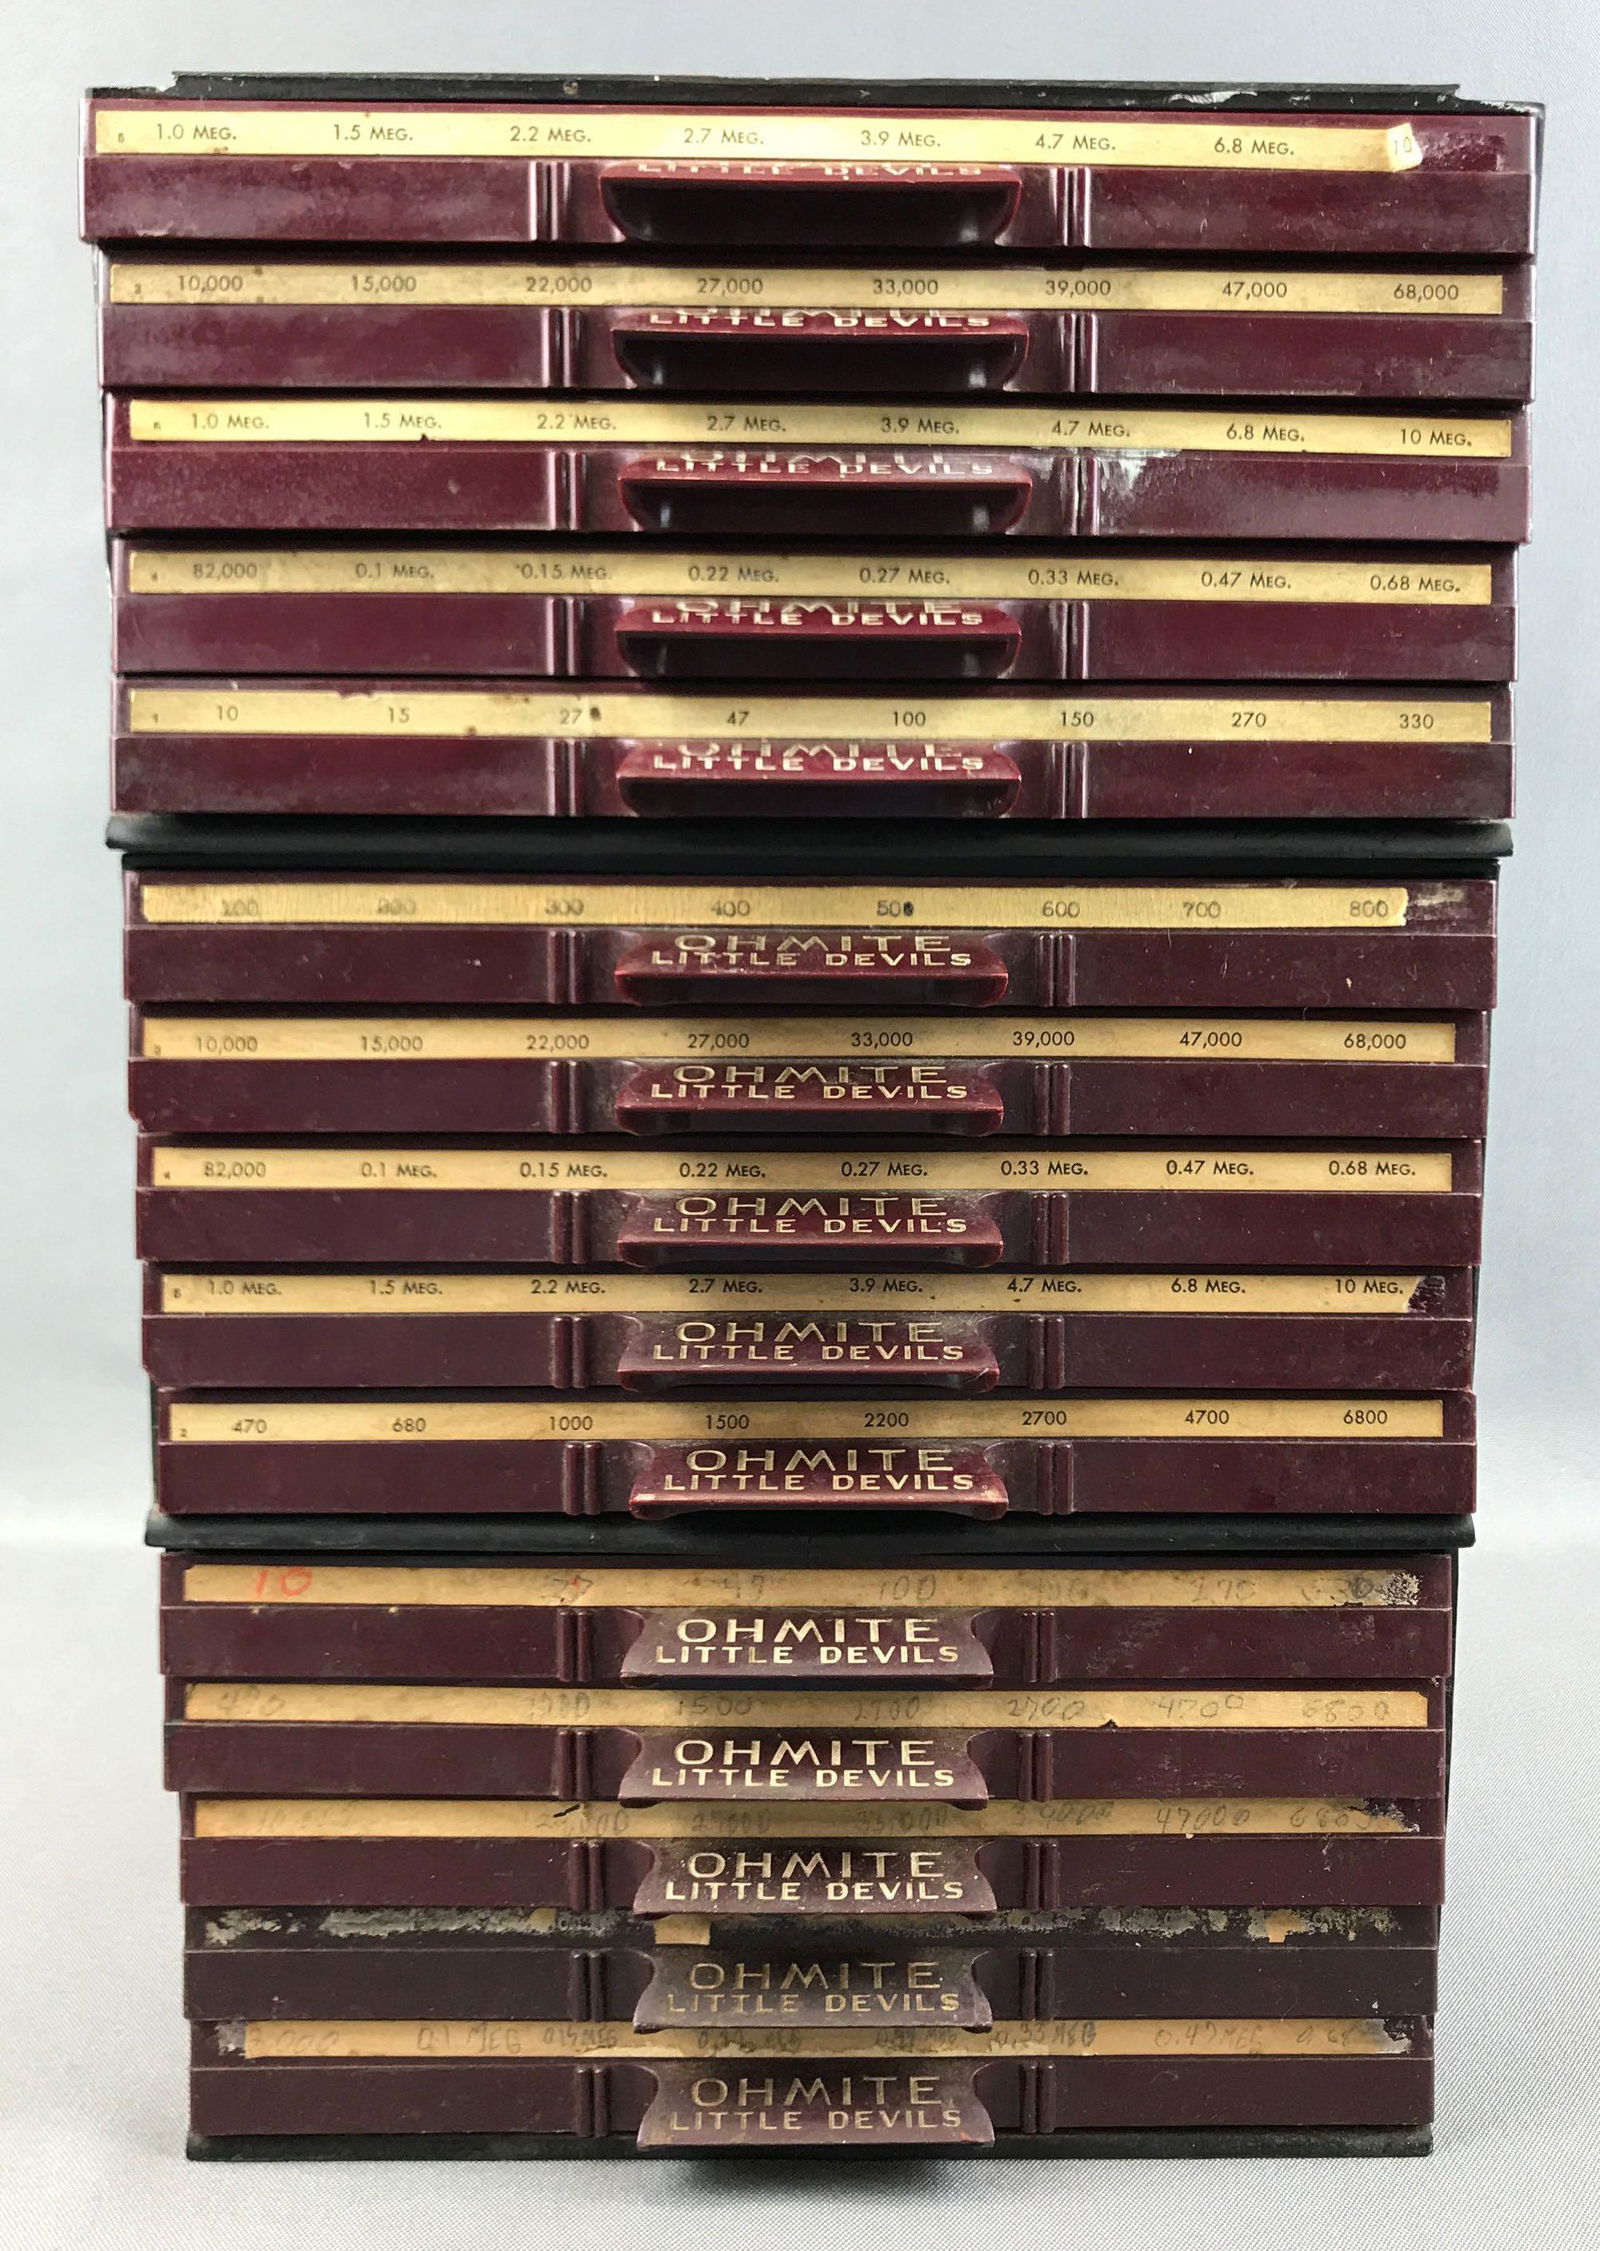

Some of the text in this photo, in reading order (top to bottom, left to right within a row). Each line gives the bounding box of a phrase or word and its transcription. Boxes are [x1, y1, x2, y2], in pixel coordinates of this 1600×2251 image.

[156, 123, 237, 141] 1.0 MEG.
[333, 123, 414, 142] 1.5 MEG.
[509, 124, 592, 143] 2.2 MEG.
[683, 127, 764, 145] 2.7 MEG.
[860, 129, 941, 148] 3.9 MEG.
[1034, 133, 1116, 151] 4.7 MEG.
[1213, 137, 1295, 156] 6.8 MEG.
[177, 274, 244, 295] 10,000
[351, 273, 417, 295] 15,000
[525, 275, 593, 295] 22,000
[697, 277, 764, 297] 27,000
[872, 277, 939, 298] 33,000
[1045, 279, 1112, 299] 39,000
[1221, 280, 1288, 301] 47,000
[1393, 282, 1460, 304] 68,000
[191, 412, 270, 430] 1.0 MEG.
[363, 411, 442, 430] 1.5 MEG.
[536, 413, 617, 431] 2.2 MEG.
[706, 415, 787, 433] 2.7 MEG.
[880, 417, 961, 436] 3.9 MEG.
[1051, 419, 1132, 438] 4.7 MEG.
[1225, 422, 1305, 442] 6.8 MEG.
[1400, 428, 1473, 447] 10 MEG.
[192, 562, 258, 580] 82,000
[354, 562, 435, 579] 0.1 MEG.
[521, 562, 612, 581] 0.15 MEG.
[688, 564, 779, 583] 0.22 MEG.
[858, 566, 951, 585] 0.27 MEG.
[1027, 567, 1119, 587] 0.33 MEG.
[1200, 570, 1292, 589] 0.47 MEG.
[1369, 574, 1461, 593] 0.68 MEG.
[216, 704, 239, 722] 10
[388, 706, 410, 724] 15
[559, 707, 583, 725] 27
[726, 710, 750, 727] 47
[892, 710, 927, 728] 100
[1060, 710, 1095, 728] 150
[1231, 710, 1268, 728] 270
[1399, 713, 1435, 730] 330
[653, 755, 983, 771] LITTLE DEVILS
[710, 899, 751, 918] 400
[1041, 900, 1081, 919] 600
[1182, 900, 1222, 919] 700
[1349, 900, 1389, 919] 800
[674, 935, 951, 952] OHMITE
[651, 951, 971, 966] LITTLE DEVILS
[195, 1035, 258, 1054] 10,000
[360, 1035, 424, 1054] 15,000
[526, 1034, 590, 1053] 22,000
[687, 1033, 750, 1052] 27,000
[850, 1031, 914, 1050] 33,000
[1012, 1030, 1075, 1049] 39,000
[1178, 1031, 1243, 1050] 47,000
[1343, 1032, 1407, 1052] 68,000
[673, 1066, 947, 1083] OHMITE
[651, 1084, 967, 1099] LITTLE DEVILS
[203, 1160, 267, 1180] 82,000
[360, 1161, 438, 1179] 0.1 MEG.
[519, 1161, 609, 1179] 0.15 MEG.
[678, 1161, 767, 1179] 0.22 MEG.
[840, 1160, 928, 1178] 0.27 MEG.
[1000, 1159, 1089, 1177] 0.33 MEG.
[1165, 1159, 1255, 1176] 0.47 MEG.
[1328, 1159, 1416, 1177] 0.68 MEG.
[676, 1197, 947, 1216] OHMITE
[653, 1218, 967, 1233] LITTLE DEVILS
[207, 1279, 283, 1296] 1.0 MEG.
[370, 1279, 444, 1296] 1.5 MEG.
[530, 1278, 607, 1295] 2.2 MEG.
[688, 1277, 763, 1294] 2.7 MEG.
[849, 1276, 923, 1294] 3.9 MEG.
[1006, 1276, 1082, 1294] 4.7 MEG.
[1170, 1277, 1246, 1294] 6.8 MEG.
[1334, 1278, 1404, 1295] 10 MEG.
[675, 1321, 943, 1343] OHMITE
[652, 1345, 964, 1361] LITTLE DEVILS
[391, 1417, 427, 1433] 680
[549, 1415, 594, 1432] 1000
[705, 1414, 751, 1431] 1500
[863, 1411, 910, 1428] 2200
[1021, 1409, 1068, 1426] 2700
[1183, 1408, 1230, 1425] 4700
[1342, 1409, 1389, 1425] 6800
[232, 1418, 268, 1435] 470
[686, 1449, 954, 1471] OHMITE
[664, 1474, 974, 1491] LITTLE DEVILS
[677, 1618, 940, 1643] OHMITE
[656, 1646, 958, 1664] LITTLE DEVILS
[674, 1740, 935, 1766] OHMITE
[651, 1768, 954, 1788] LITTLE DEVILS
[688, 1852, 944, 1878] OHMITE
[666, 1881, 964, 1901] LITTLE DEVILS
[689, 1962, 940, 1990] OHMITE
[667, 1993, 960, 2013] LITTLE DEVILS
[691, 2076, 942, 2107] OHMITE
[669, 2110, 961, 2131] LITTLE DEVILS
